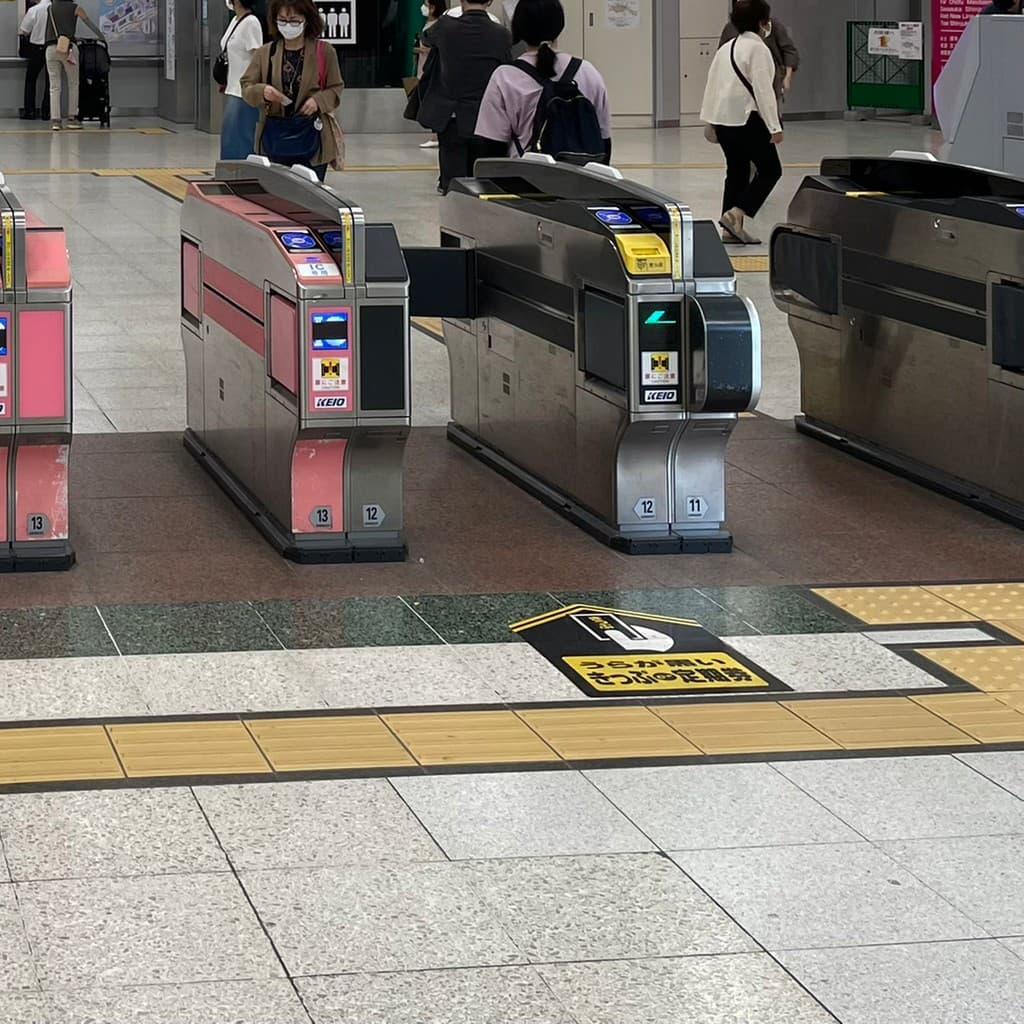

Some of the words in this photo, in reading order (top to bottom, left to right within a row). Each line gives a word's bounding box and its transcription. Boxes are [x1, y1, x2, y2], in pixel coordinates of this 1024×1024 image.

[316, 398, 346, 407] KEIO
[646, 391, 676, 401] KEIO
[641, 500, 653, 513] 12
[689, 499, 701, 512] 11
[316, 509, 328, 522] 13
[366, 506, 377, 520] 12
[31, 516, 43, 530] 13
[579, 658, 727, 670] うらが黒い
